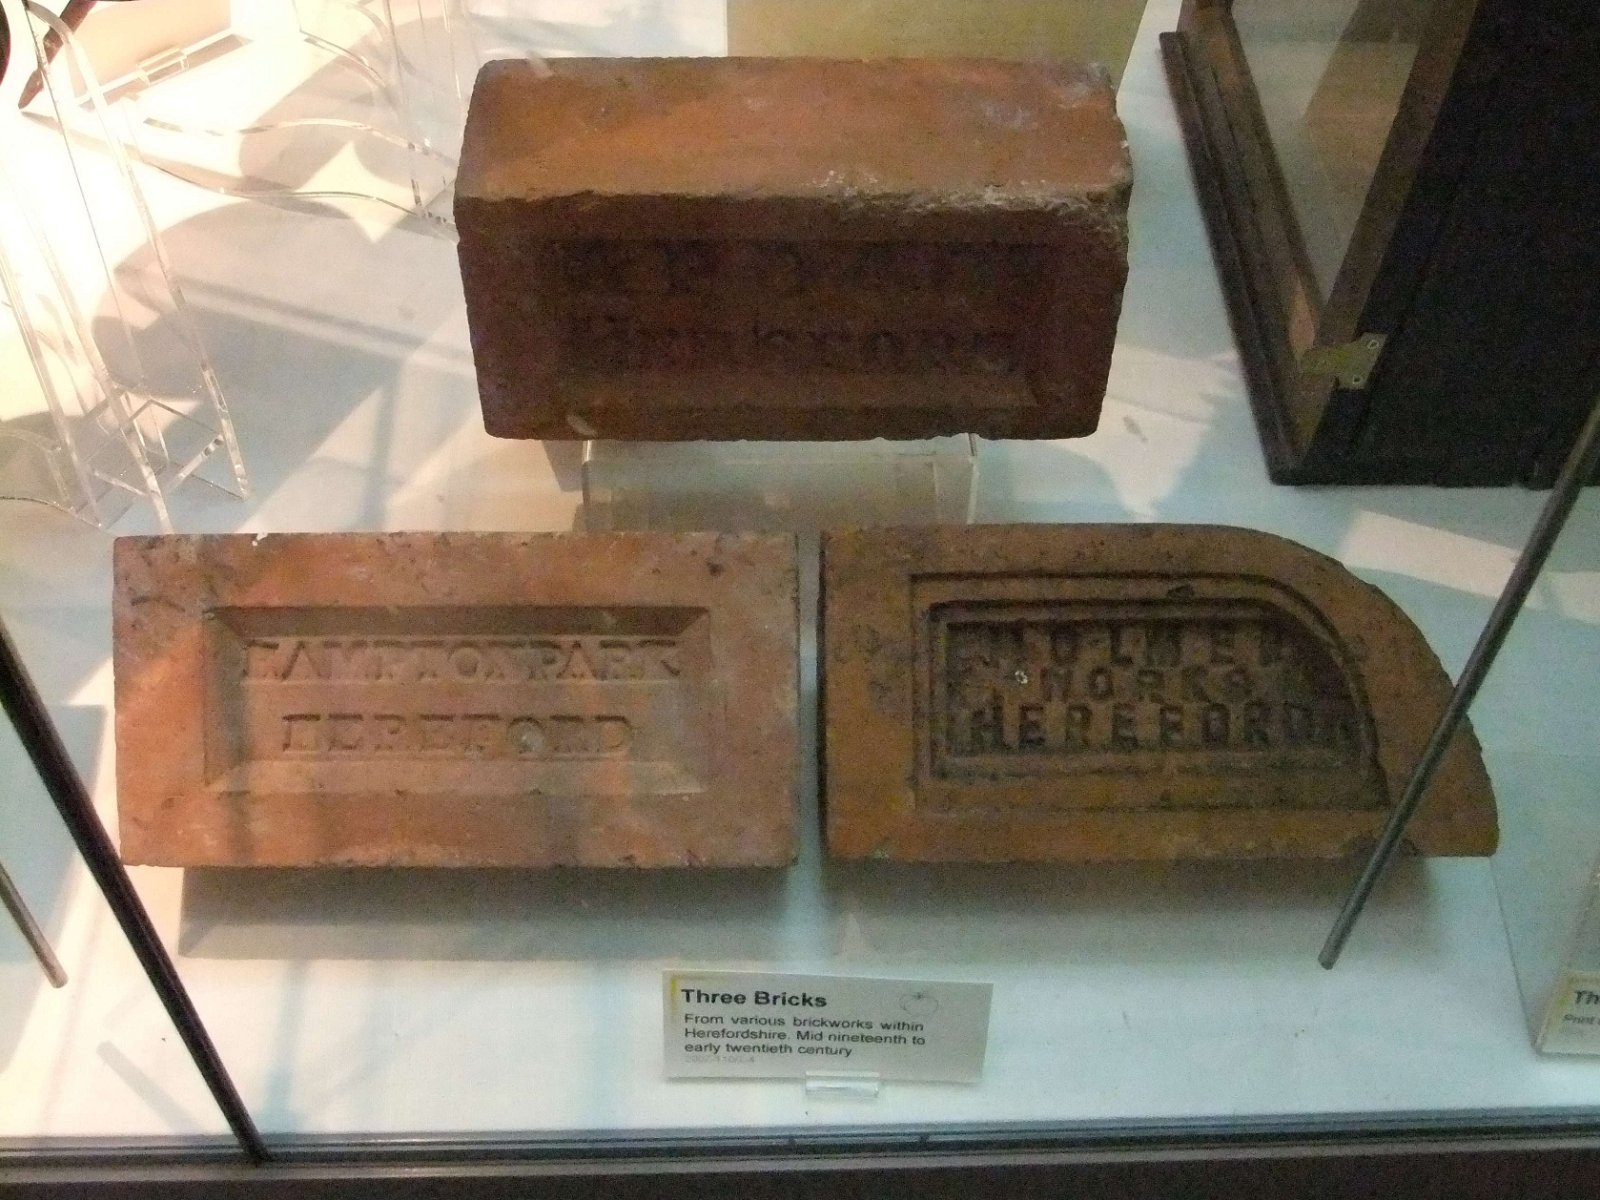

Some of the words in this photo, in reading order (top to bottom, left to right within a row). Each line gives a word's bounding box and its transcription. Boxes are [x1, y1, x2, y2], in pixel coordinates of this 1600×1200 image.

[529, 638, 682, 681] PARK
[968, 698, 1314, 752] HEREFORD
[680, 988, 747, 1005] Three
[753, 990, 828, 1008] Bricks
[1574, 990, 1600, 1005] Th
[684, 1013, 725, 1026] From
[730, 1016, 786, 1028] various
[792, 1016, 874, 1031] brickworks
[879, 1019, 925, 1033] within
[684, 1028, 791, 1042] Herefordshire.
[795, 1030, 824, 1042] Mid
[827, 1031, 908, 1046] nineteenth
[911, 1033, 926, 1047] to
[684, 1042, 721, 1055] early
[725, 1042, 793, 1055] twentieth
[797, 1045, 853, 1058] century
